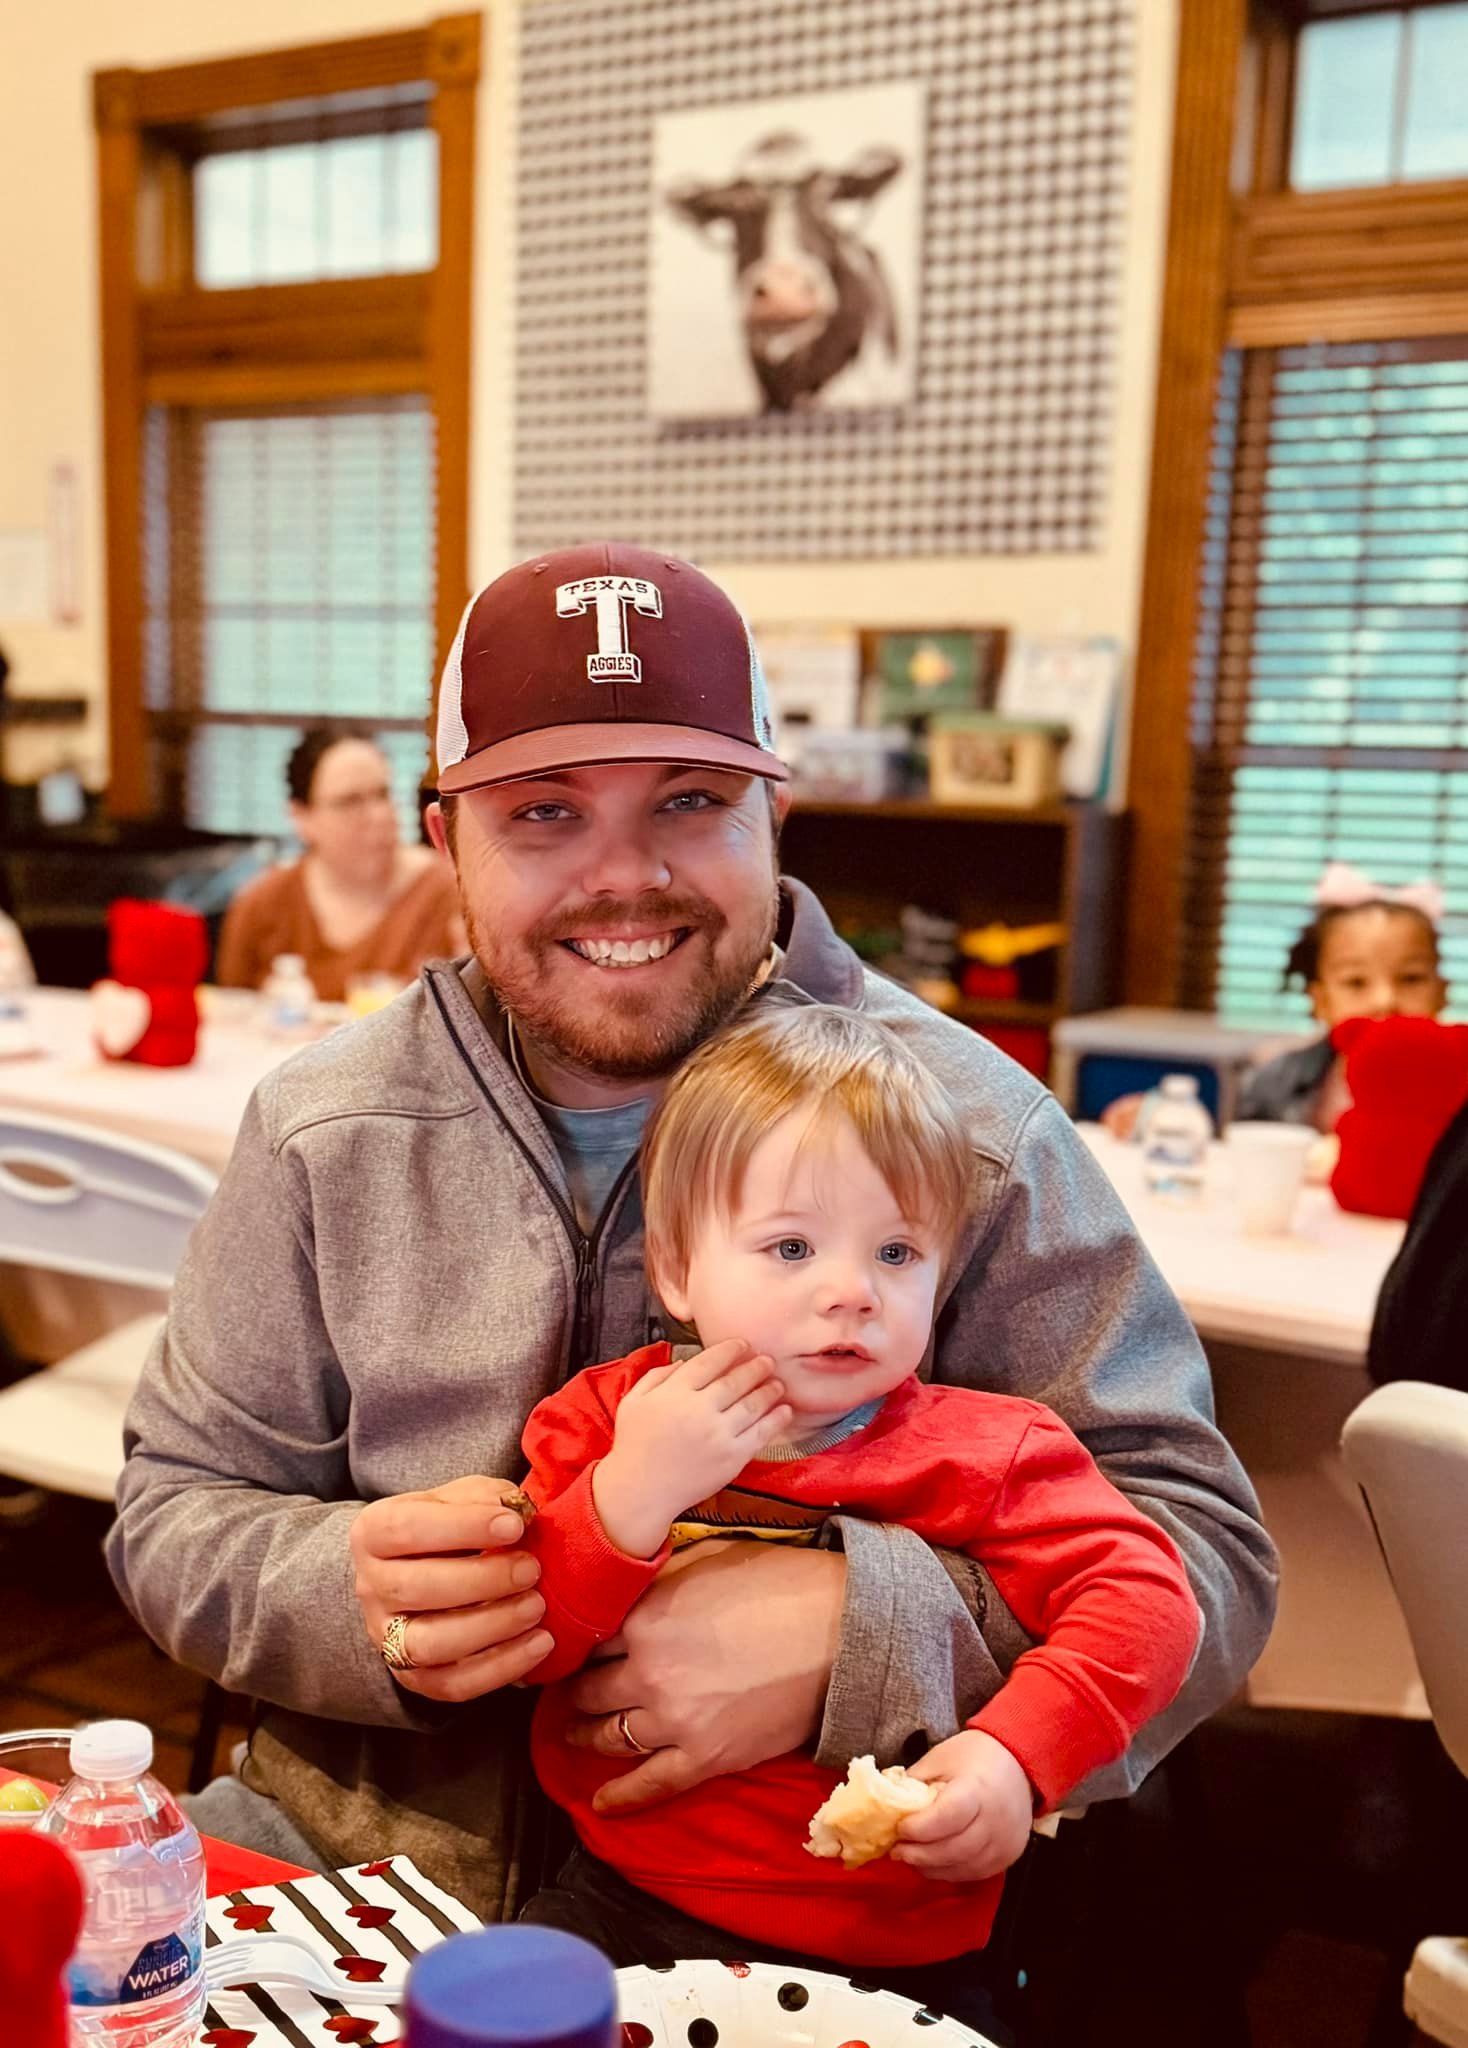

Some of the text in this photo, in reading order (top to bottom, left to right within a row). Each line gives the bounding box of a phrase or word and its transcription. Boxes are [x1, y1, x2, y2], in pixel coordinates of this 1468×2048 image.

[564, 579, 648, 595] TEXAS
[556, 575, 662, 683] T
[589, 656, 632, 672] AGGIES
[128, 1955, 189, 1990] WATER
